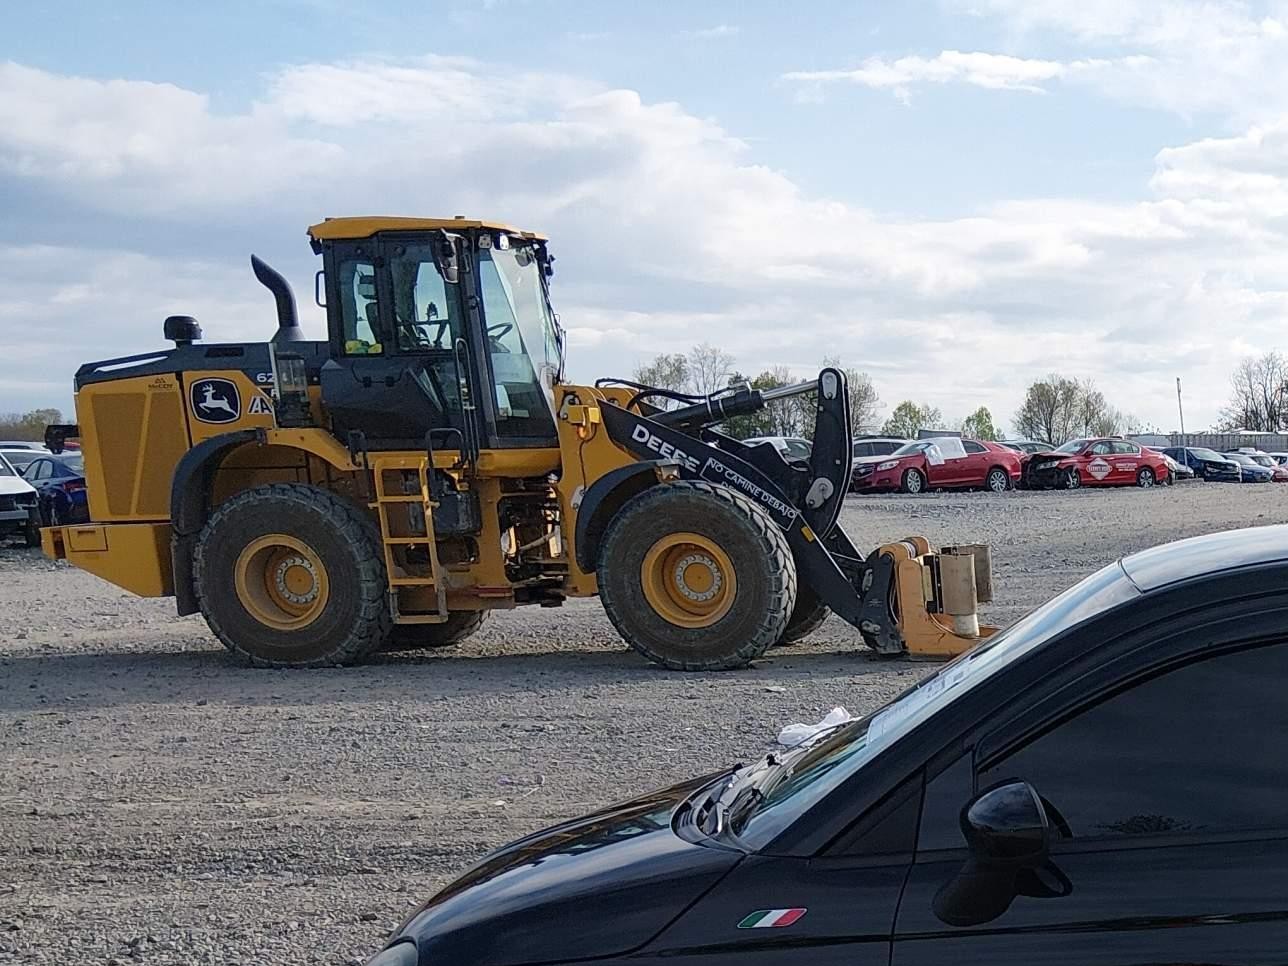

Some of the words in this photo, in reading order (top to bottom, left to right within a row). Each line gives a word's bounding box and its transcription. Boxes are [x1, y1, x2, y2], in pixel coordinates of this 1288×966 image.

[631, 424, 701, 473] DEERE
[710, 459, 724, 473] NO
[724, 470, 761, 497] CAMINE
[761, 490, 796, 519] DEBAJO
